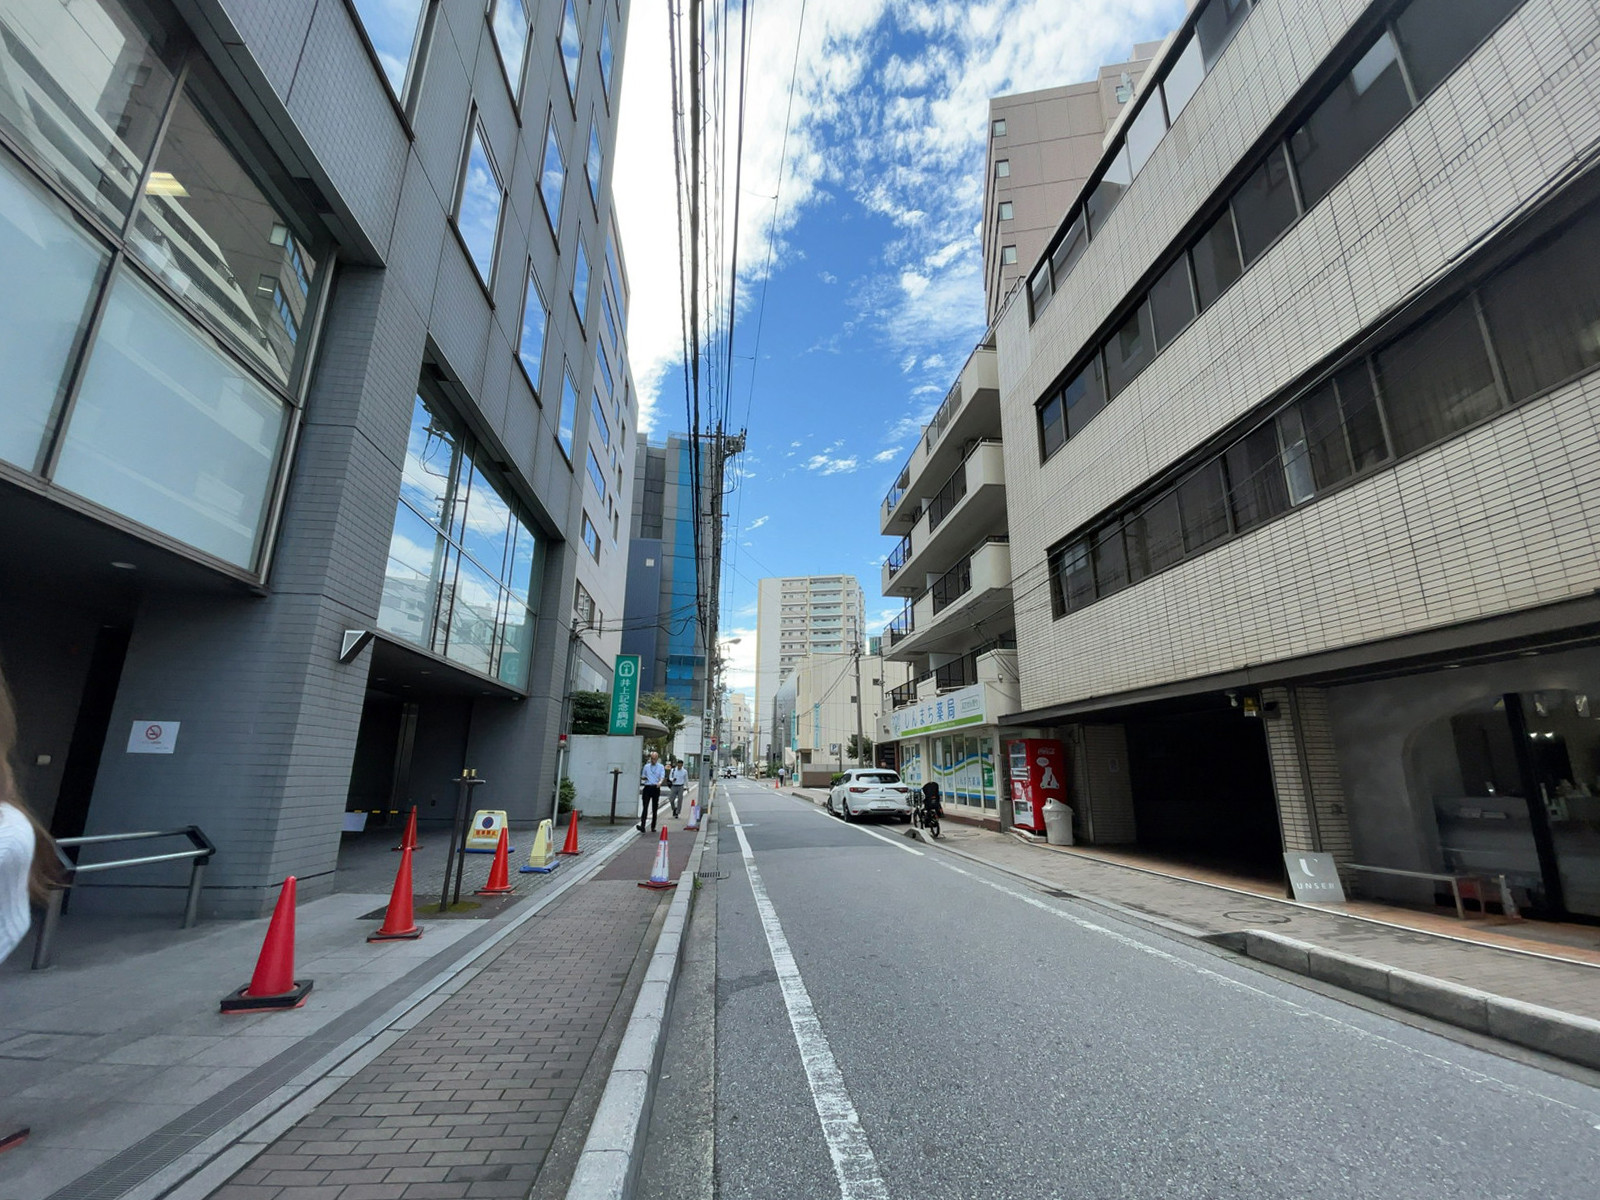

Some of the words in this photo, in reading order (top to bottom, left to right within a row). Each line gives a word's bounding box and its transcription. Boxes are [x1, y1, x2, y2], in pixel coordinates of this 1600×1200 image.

[615, 678, 631, 728] 井上記念病院
[904, 697, 956, 729] しんまち薬局
